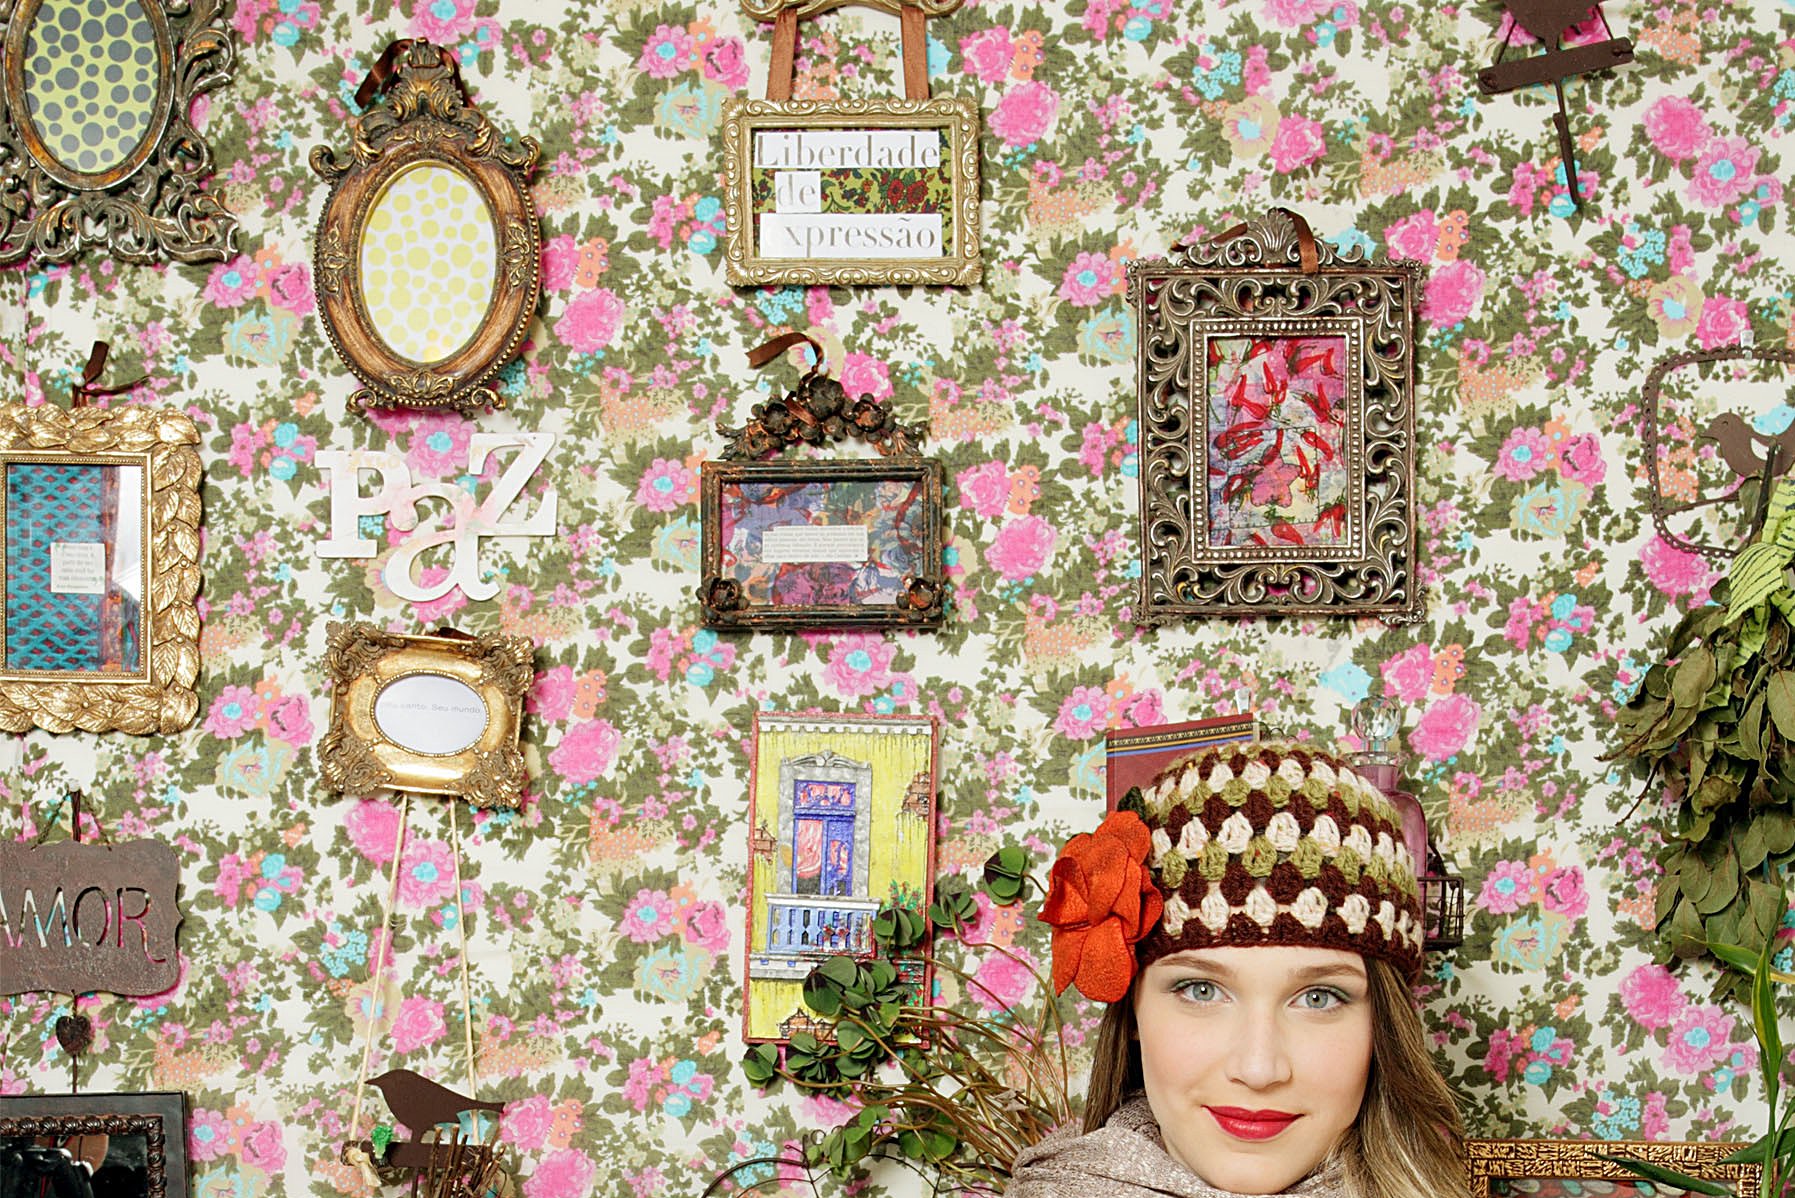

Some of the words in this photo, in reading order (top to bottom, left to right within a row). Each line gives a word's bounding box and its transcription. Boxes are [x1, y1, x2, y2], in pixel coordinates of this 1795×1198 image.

[757, 134, 938, 168] Liberdade
[777, 174, 816, 206] de
[767, 217, 935, 258] xpressão
